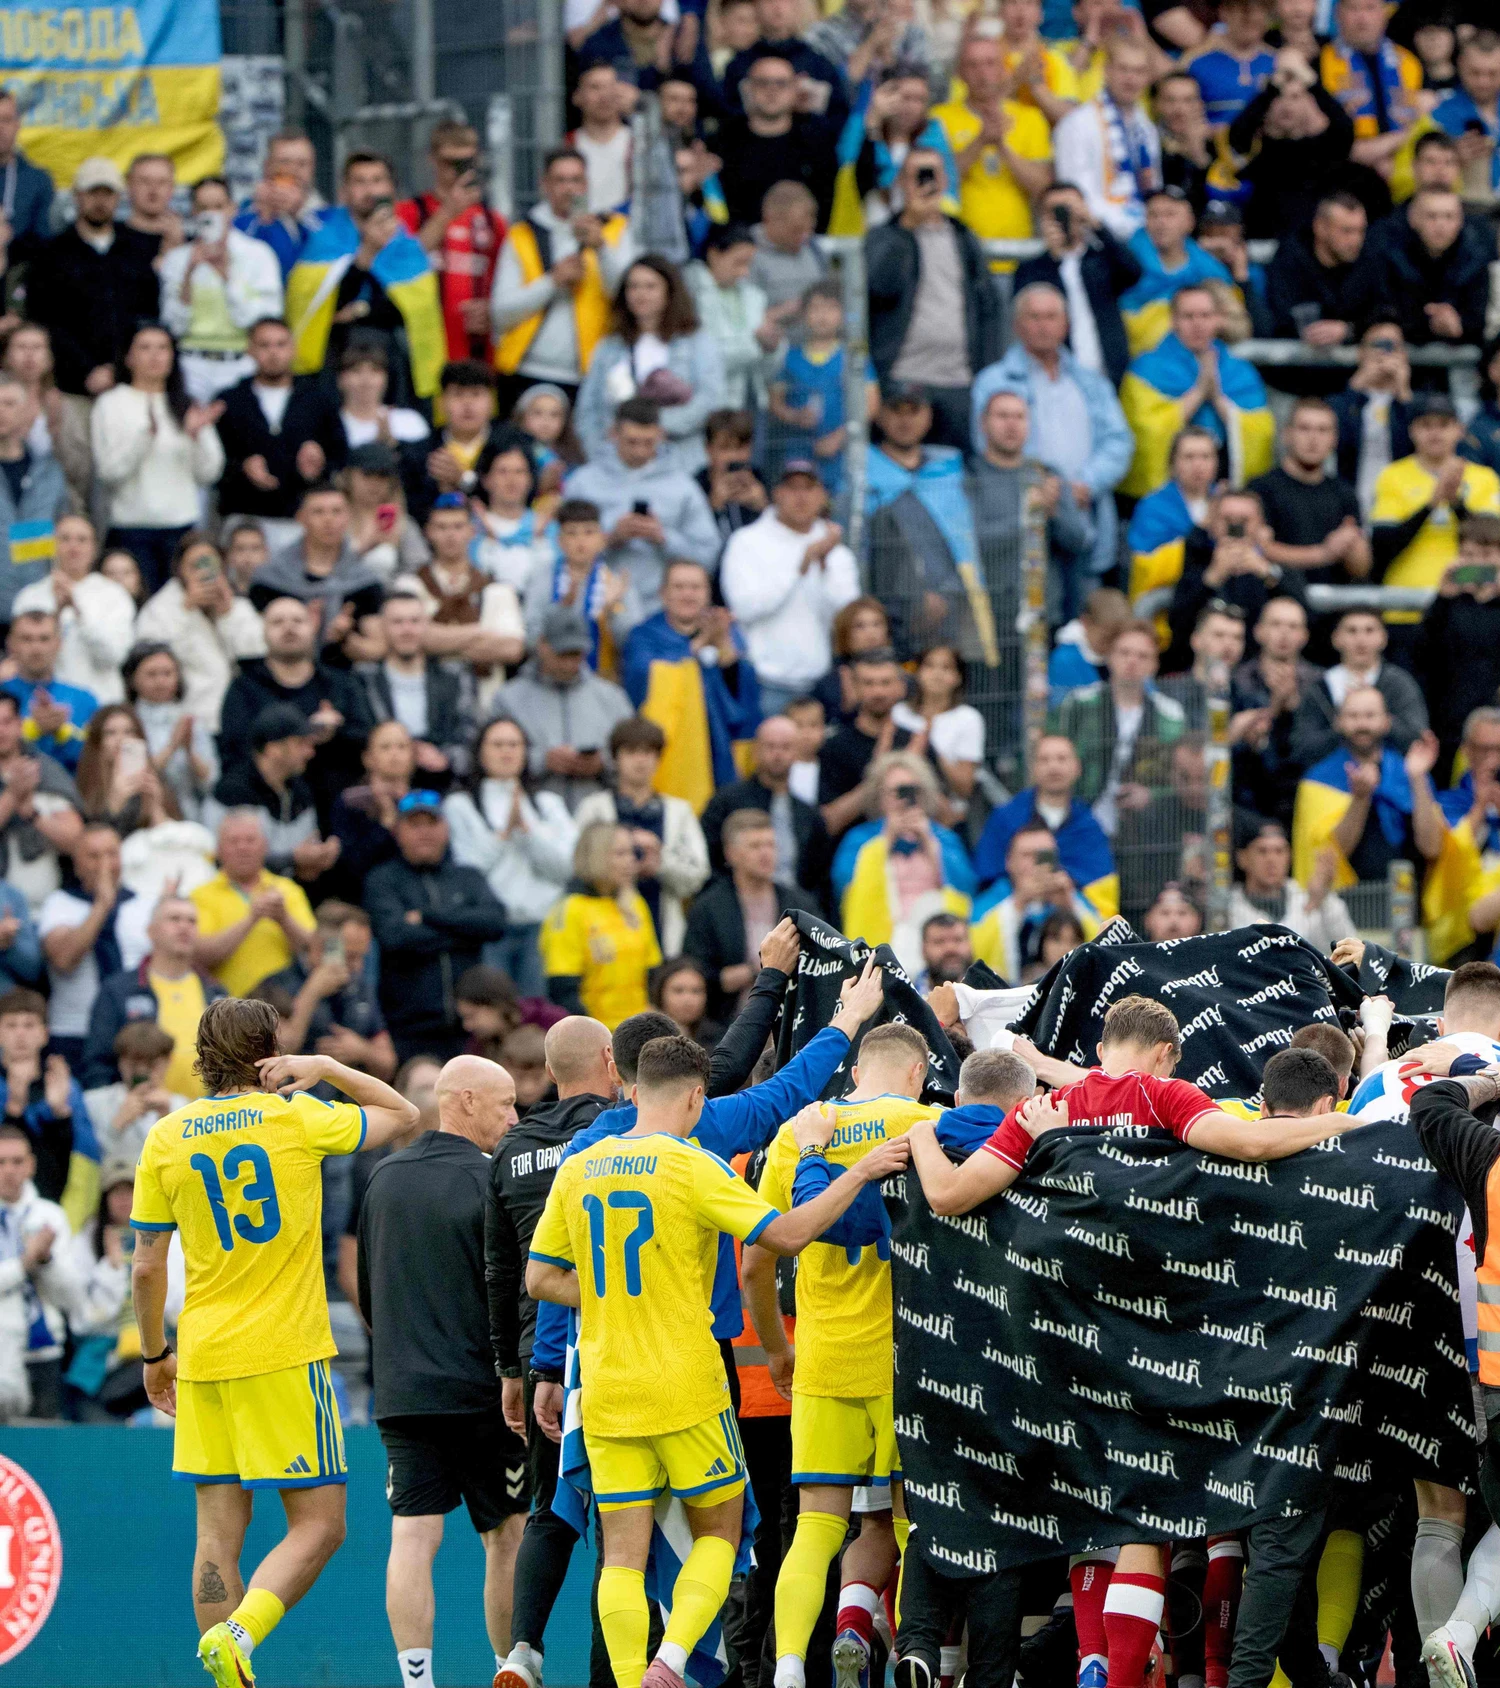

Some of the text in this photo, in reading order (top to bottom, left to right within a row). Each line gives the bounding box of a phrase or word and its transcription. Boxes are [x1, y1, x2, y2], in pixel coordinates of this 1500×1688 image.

[181, 1108, 264, 1139] ZABARNYI
[826, 1118, 886, 1149] OVBYK
[511, 1151, 533, 1178] FOR
[584, 1156, 658, 1180] SUDAKOV
[190, 1143, 281, 1252] 13
[582, 1190, 655, 1298] 17
